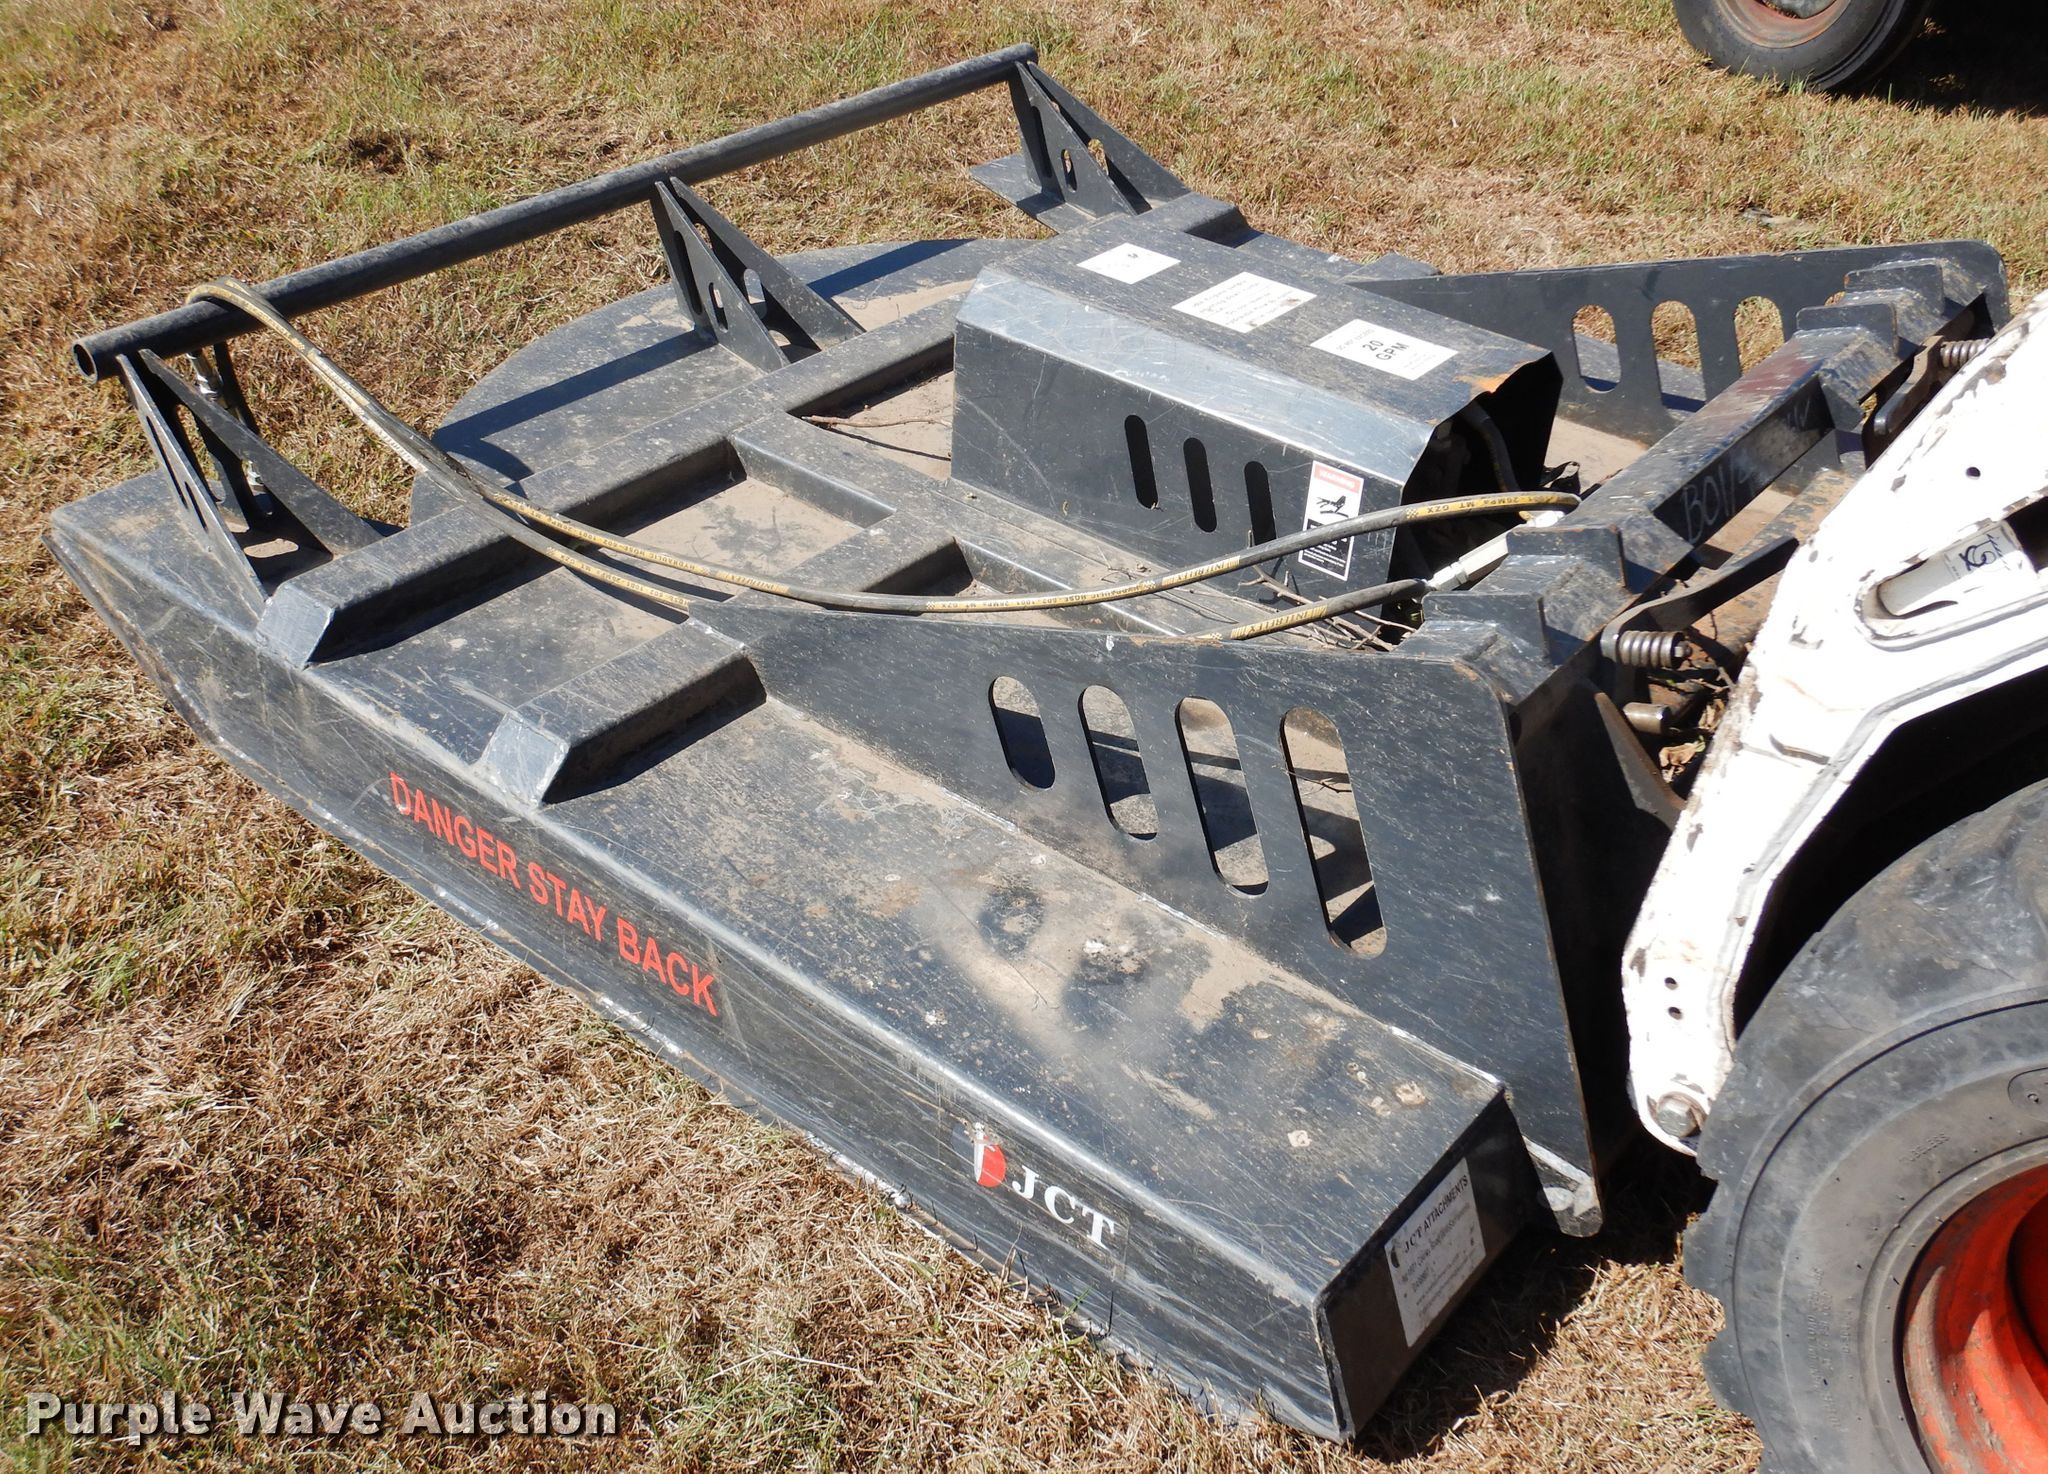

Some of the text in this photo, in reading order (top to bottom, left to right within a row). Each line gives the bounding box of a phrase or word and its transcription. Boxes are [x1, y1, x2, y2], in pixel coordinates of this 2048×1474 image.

[1362, 339, 1385, 352] 20
[1375, 341, 1411, 361] GPM
[389, 771, 718, 1017] DANGER STAY BACK
[1012, 1165, 1116, 1250] JCT
[1423, 1174, 1470, 1233] ATTACHMENTS
